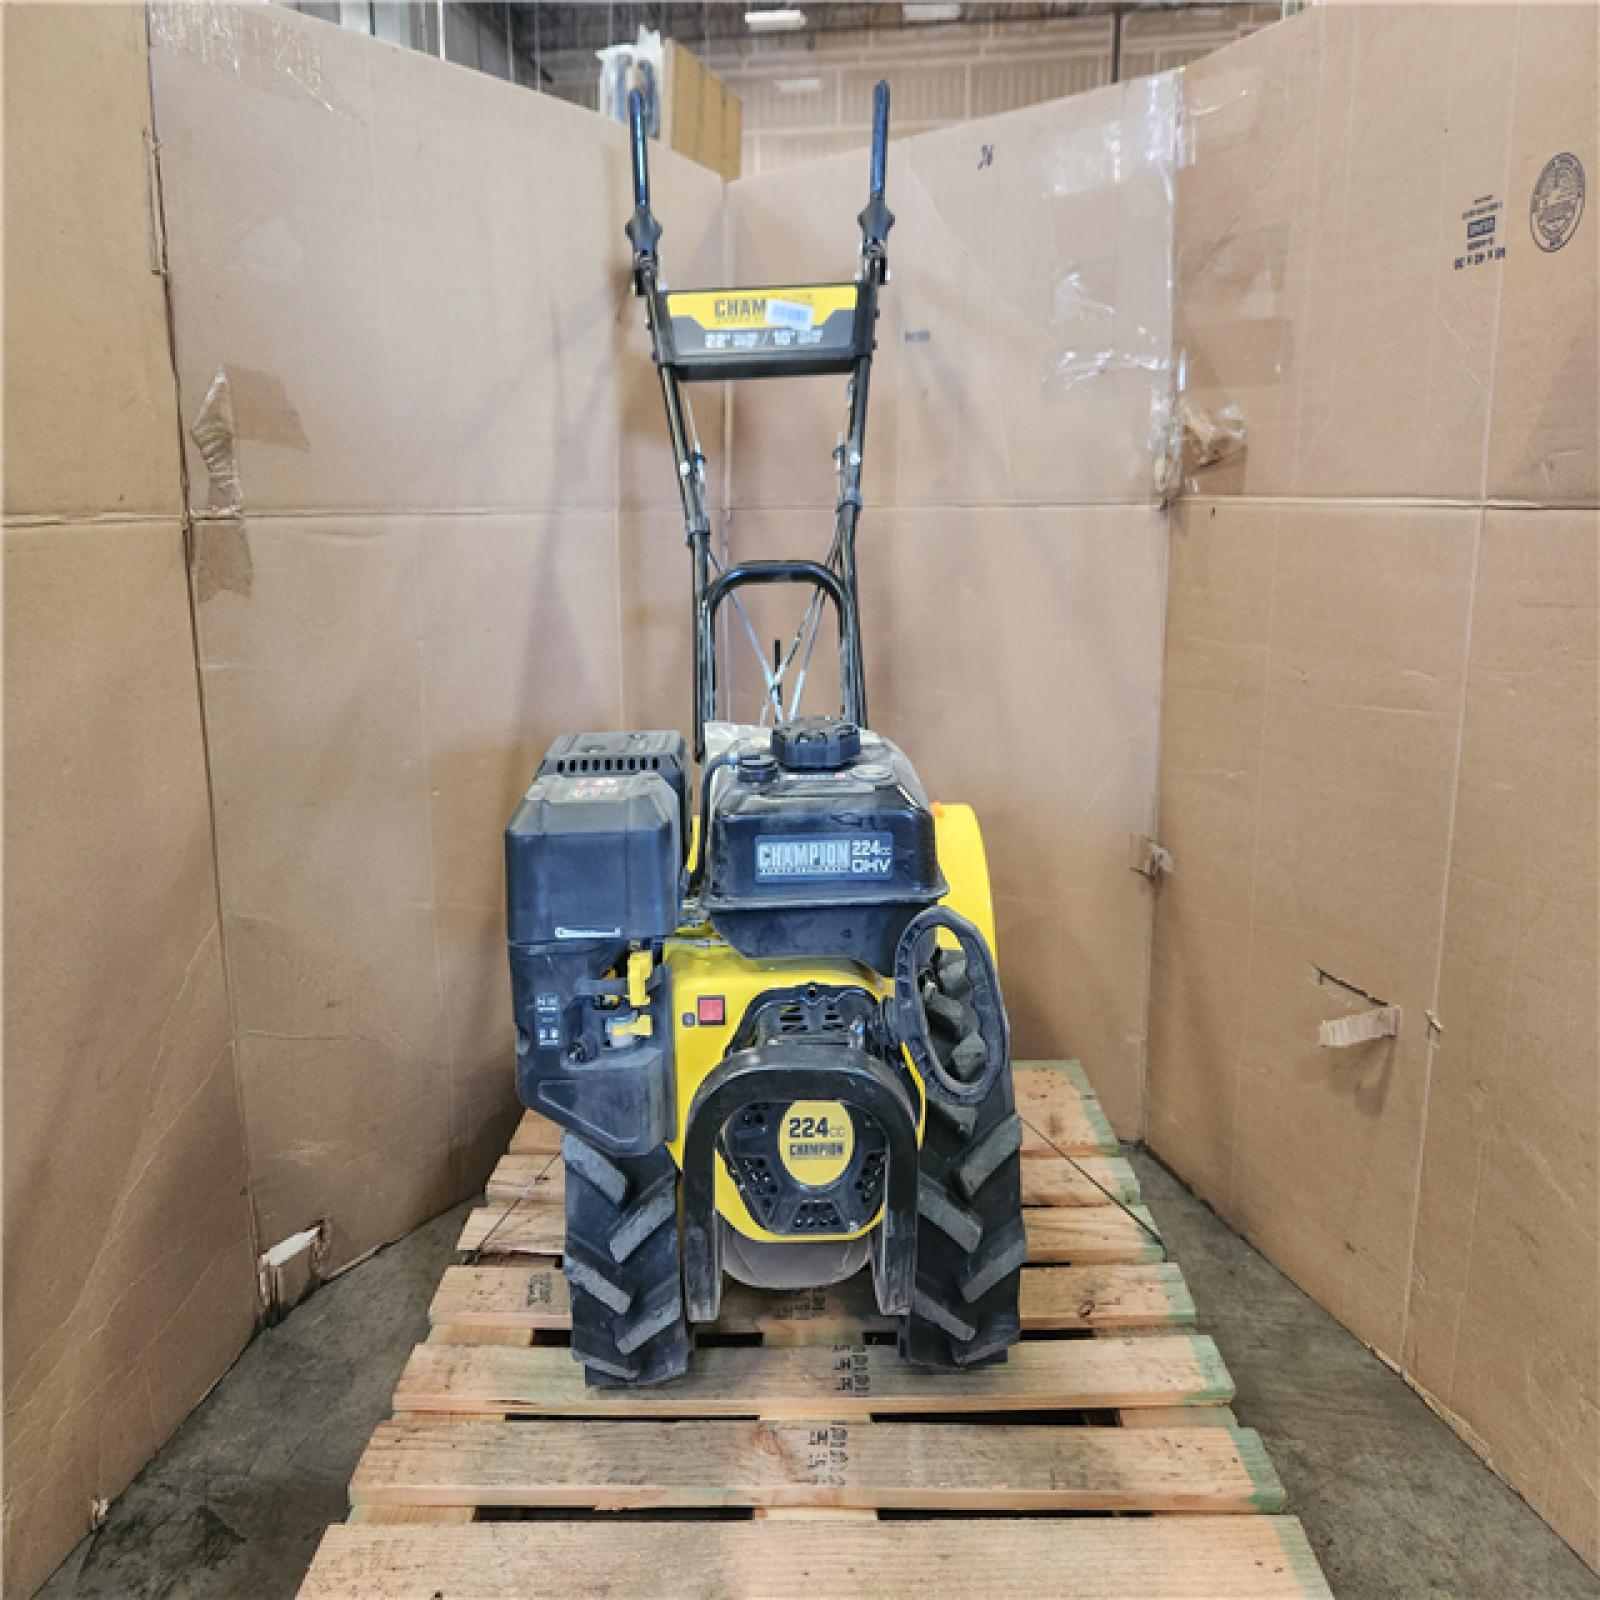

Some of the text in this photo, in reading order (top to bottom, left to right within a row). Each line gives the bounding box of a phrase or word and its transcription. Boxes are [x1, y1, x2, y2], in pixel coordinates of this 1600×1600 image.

[758, 841, 850, 867] CHAMPION
[852, 858, 891, 873] OHV
[789, 1143, 844, 1157] CHAMPION
